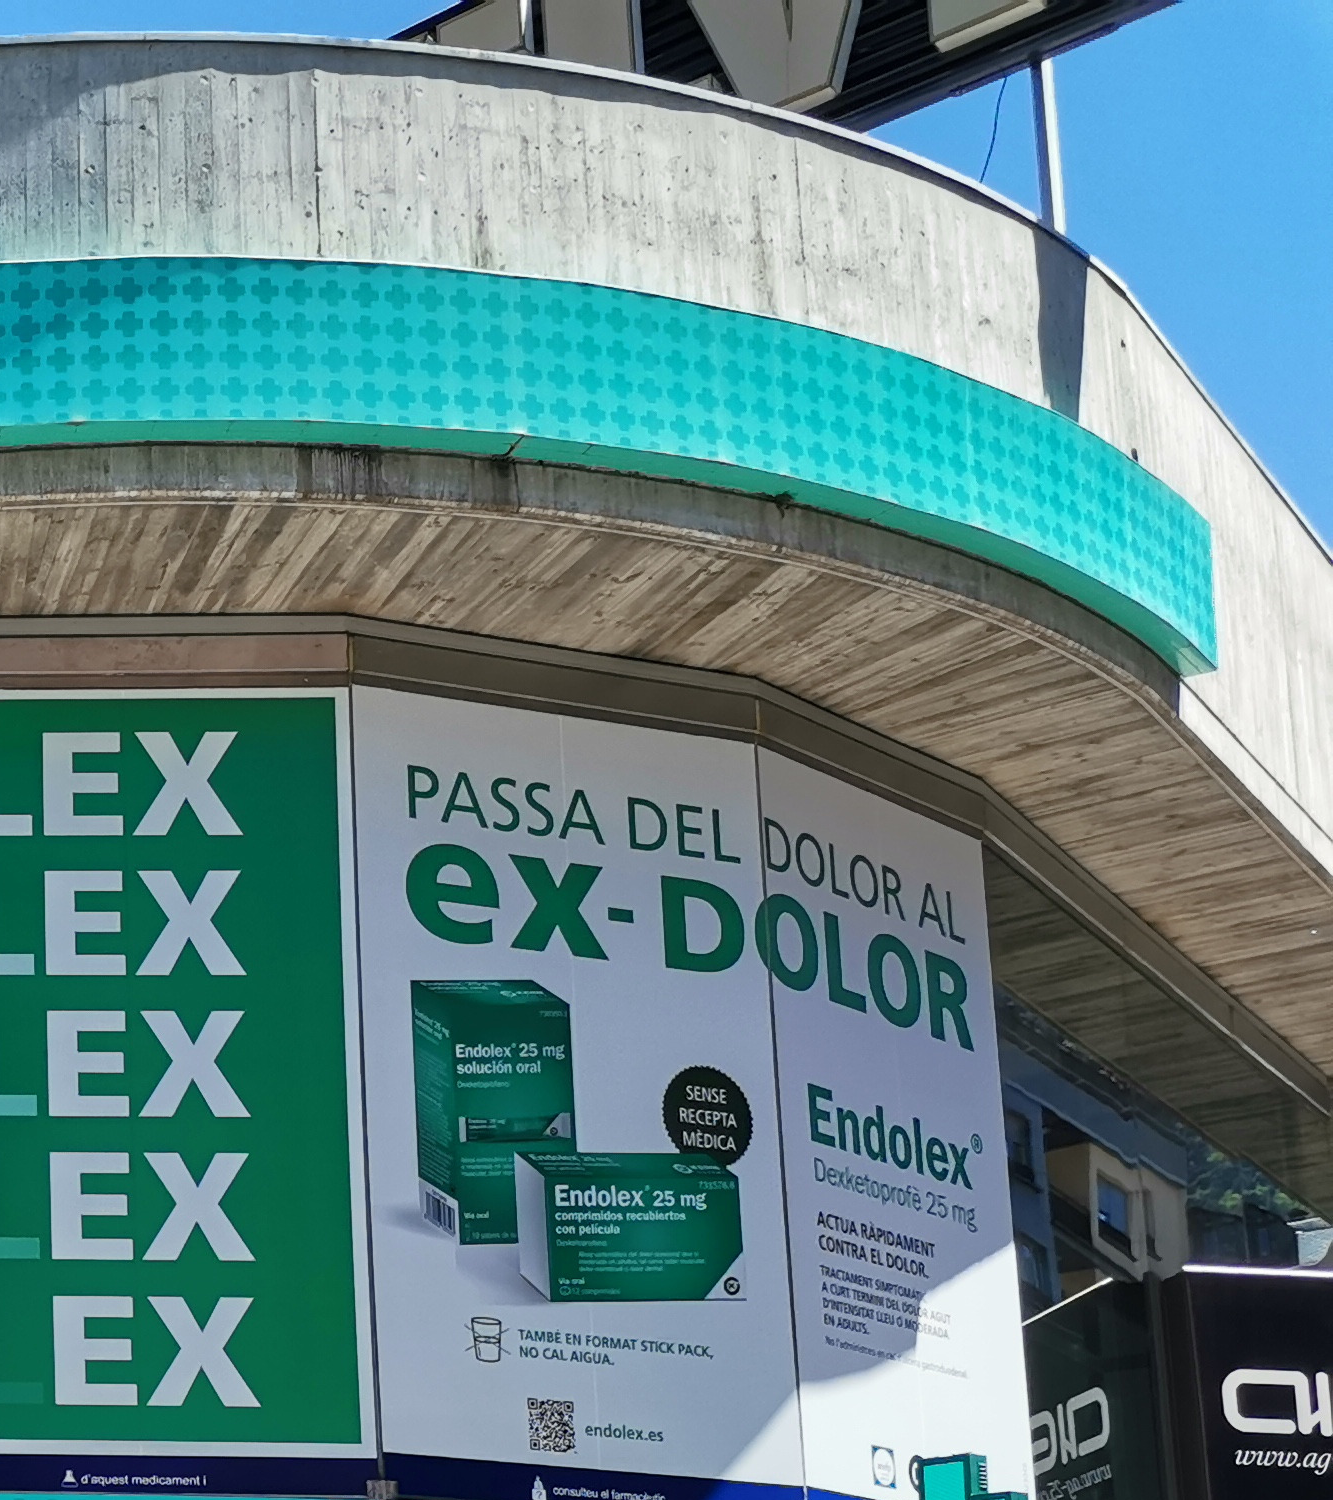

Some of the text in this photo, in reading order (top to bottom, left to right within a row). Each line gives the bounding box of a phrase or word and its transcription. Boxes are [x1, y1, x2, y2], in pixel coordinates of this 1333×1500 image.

[405, 764, 966, 945] PASSA DEL DOLOR AL
[519, 1043, 537, 1057] 25
[543, 1045, 565, 1060] mg
[457, 1060, 541, 1074] solución oral
[686, 1085, 727, 1104] SENSE
[679, 1107, 738, 1128] RECEPTA
[682, 1128, 737, 1152] MÈDICA
[652, 1191, 675, 1207] 25
[680, 1193, 707, 1210] mg
[813, 1157, 978, 1233] Dexketoprofè 25 mg
[555, 1210, 686, 1223] comprimidos recubiertos
[555, 1225, 575, 1234] con
[817, 1211, 935, 1258] ACTUA RÀPIDAMENT
[818, 1234, 868, 1262] CONTRA
[870, 1248, 884, 1267] EL
[819, 1264, 873, 1289] TRACTAMENT
[885, 1297, 900, 1311] DEL
[824, 1314, 835, 1326] EN
[565, 1333, 581, 1346] EN
[586, 1335, 638, 1350] FORMAT
[641, 1340, 674, 1354] STICK
[520, 1346, 538, 1358] NO
[543, 1349, 568, 1361] CAL
[585, 1424, 664, 1442] endolex.es
[81, 1474, 128, 1486] d'aquest
[131, 1475, 200, 1486] medicament
[553, 1486, 598, 1499] consulteu
[601, 1489, 609, 1499] el
